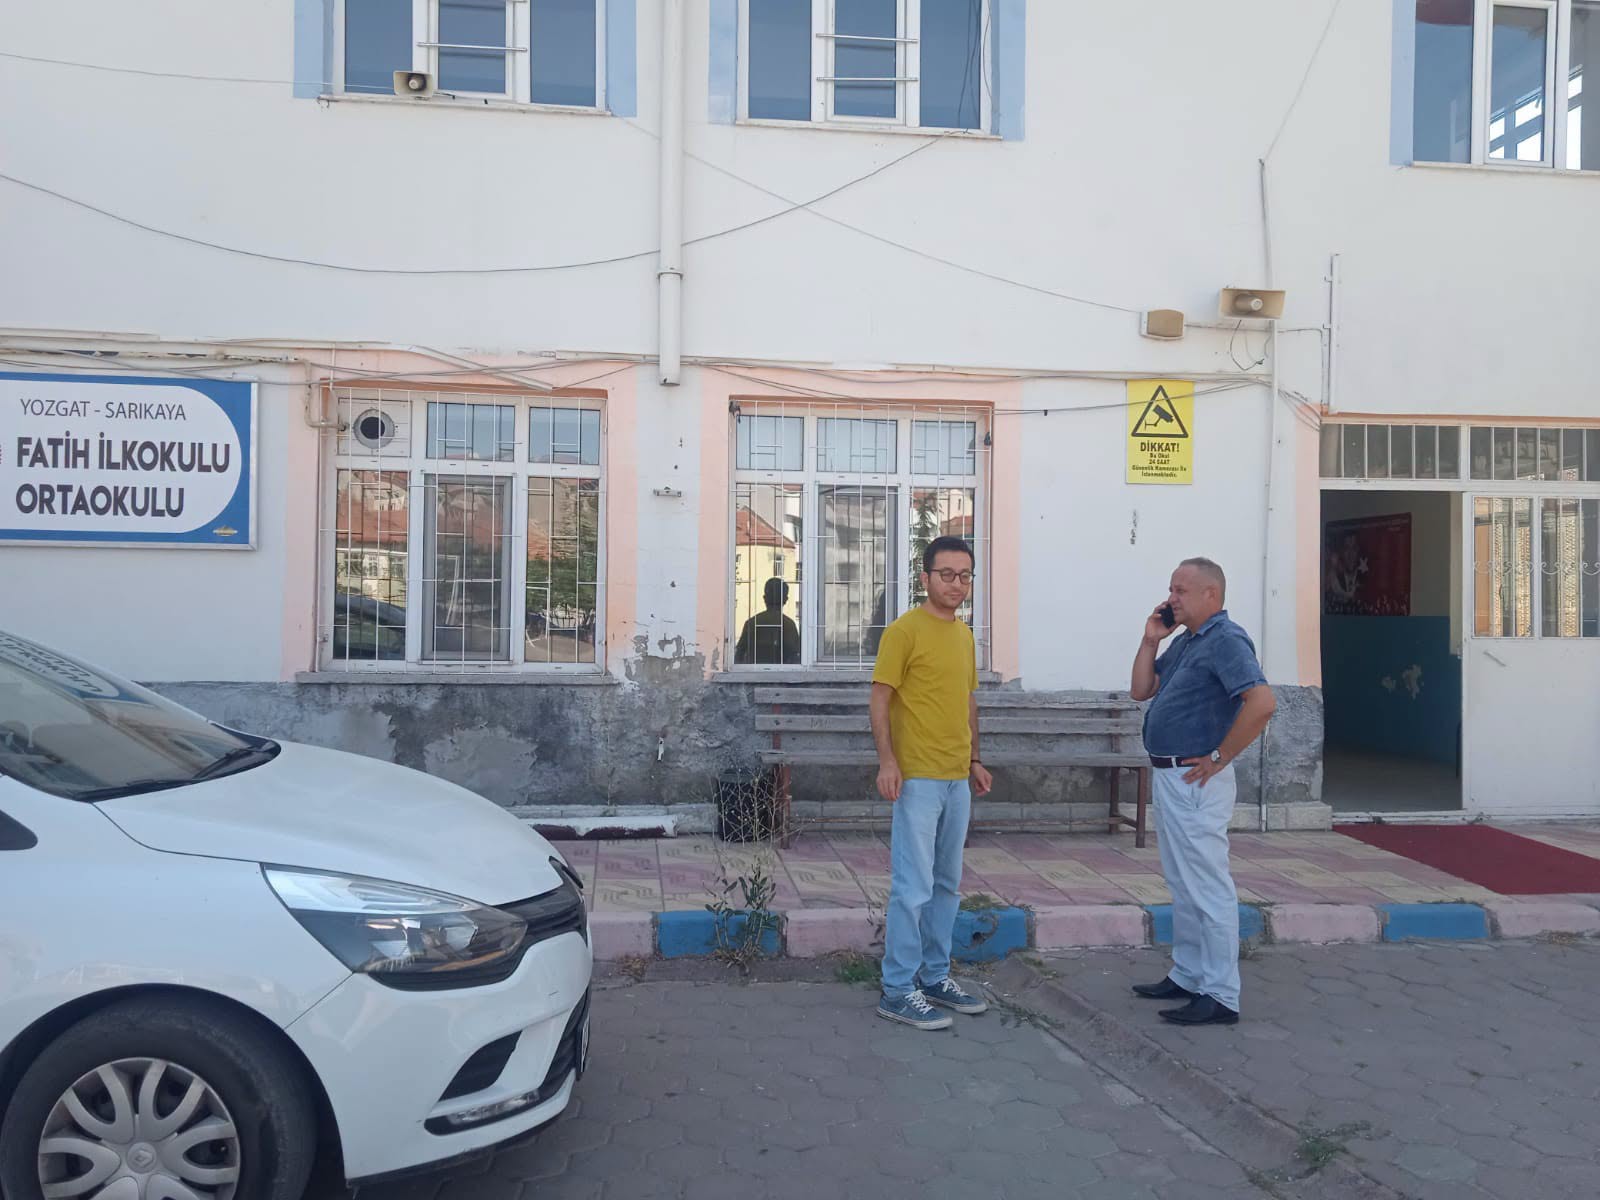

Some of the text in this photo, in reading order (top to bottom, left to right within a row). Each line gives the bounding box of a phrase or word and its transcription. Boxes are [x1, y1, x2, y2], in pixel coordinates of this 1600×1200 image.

[20, 398, 90, 418] YOZGAT
[105, 401, 187, 421] SARIKAYA
[17, 430, 230, 474] FATİH İLKOKULU
[1140, 440, 1180, 452] DİKKAT!
[16, 483, 185, 518] ORTAOKULU
